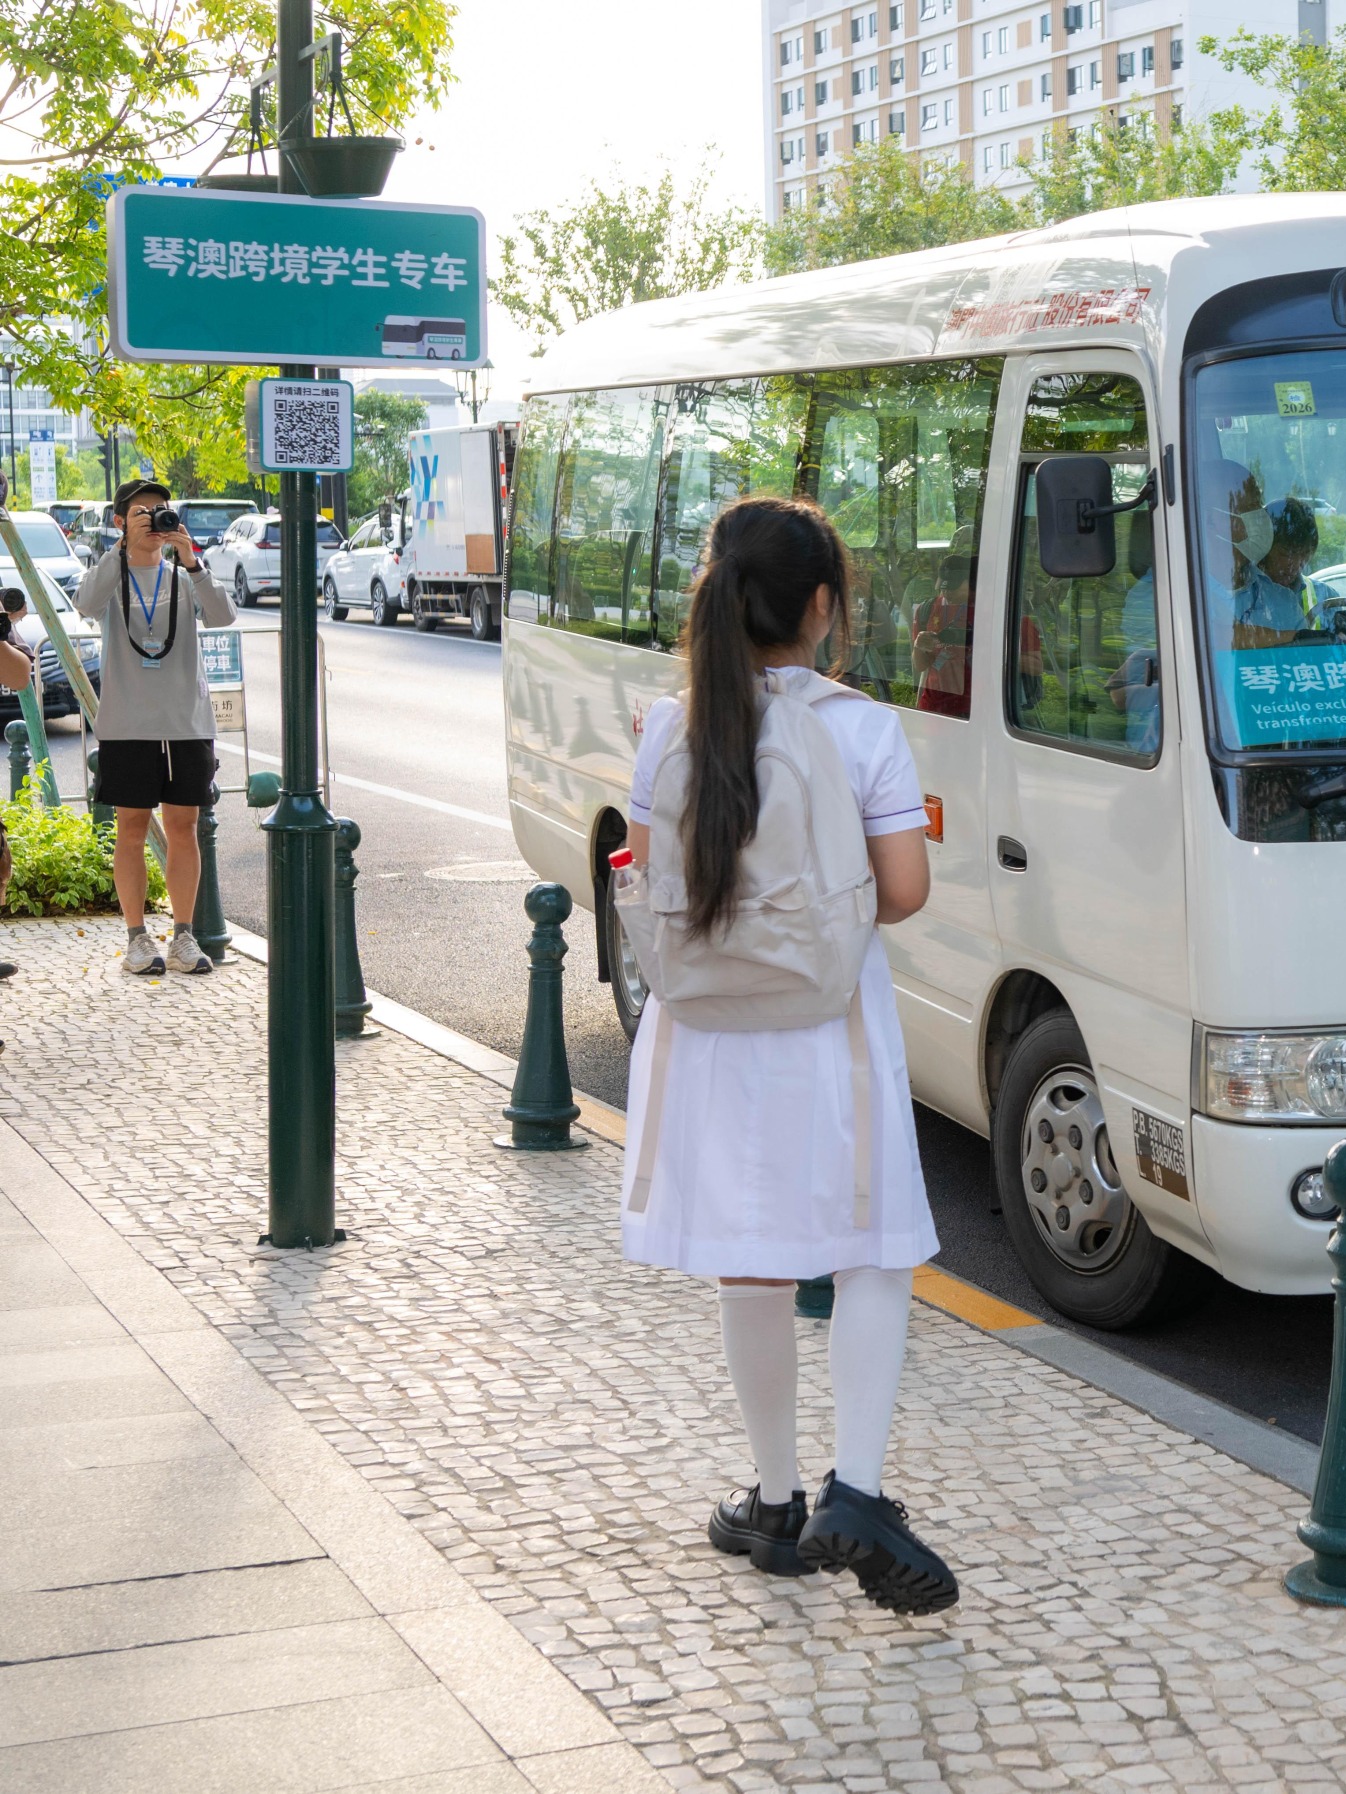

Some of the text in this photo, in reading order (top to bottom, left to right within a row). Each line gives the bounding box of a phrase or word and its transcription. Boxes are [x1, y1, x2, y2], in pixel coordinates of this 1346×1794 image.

[142, 236, 469, 292] 琴澳跨境学生专车
[274, 385, 339, 397] 详情请扫二维码
[1282, 403, 1313, 414] 2026
[1251, 701, 1311, 714] Veículo
[1133, 1110, 1184, 1153] P.B. 5670KGS
[1152, 1162, 1163, 1187] 19
